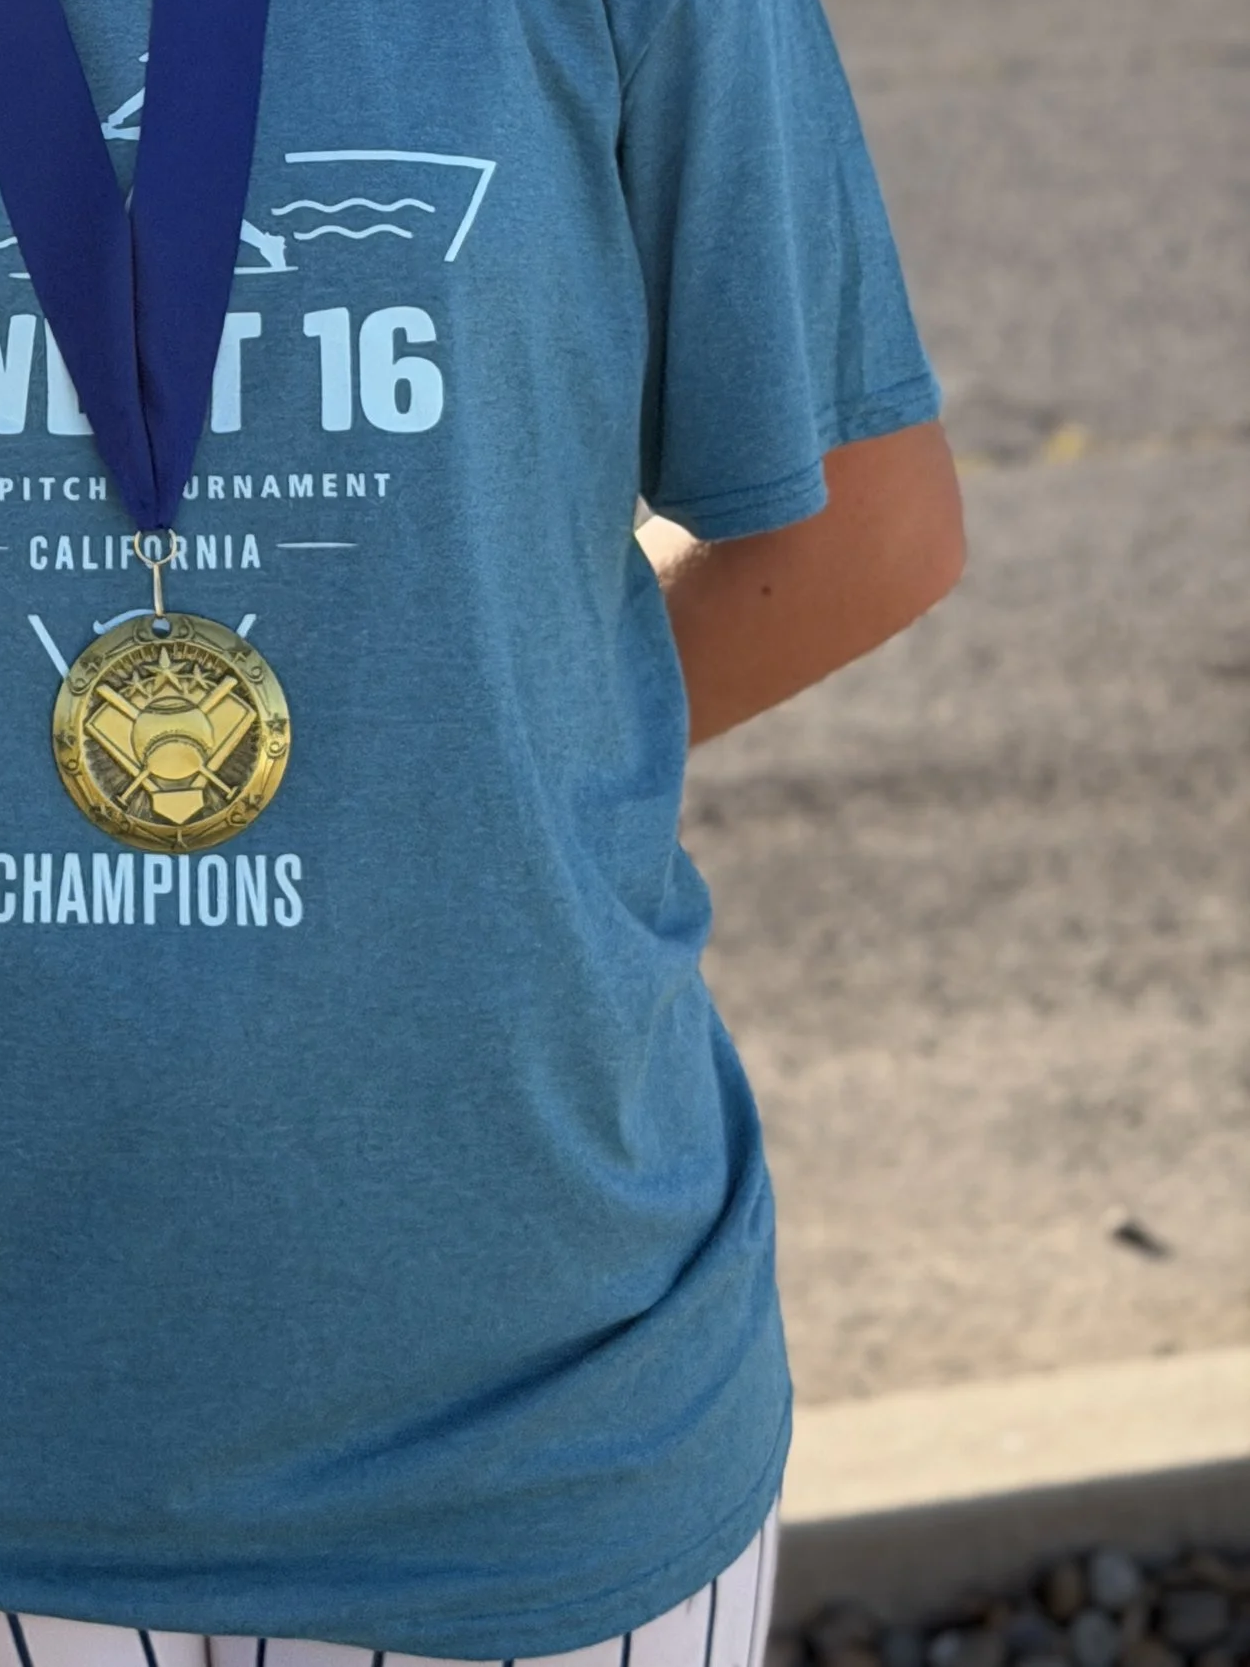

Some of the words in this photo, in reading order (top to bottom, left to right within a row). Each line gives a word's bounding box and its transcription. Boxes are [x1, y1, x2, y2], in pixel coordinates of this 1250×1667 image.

[302, 305, 445, 433] 16
[180, 471, 393, 500] URNAMENT
[28, 531, 263, 571] CALIFORNIA
